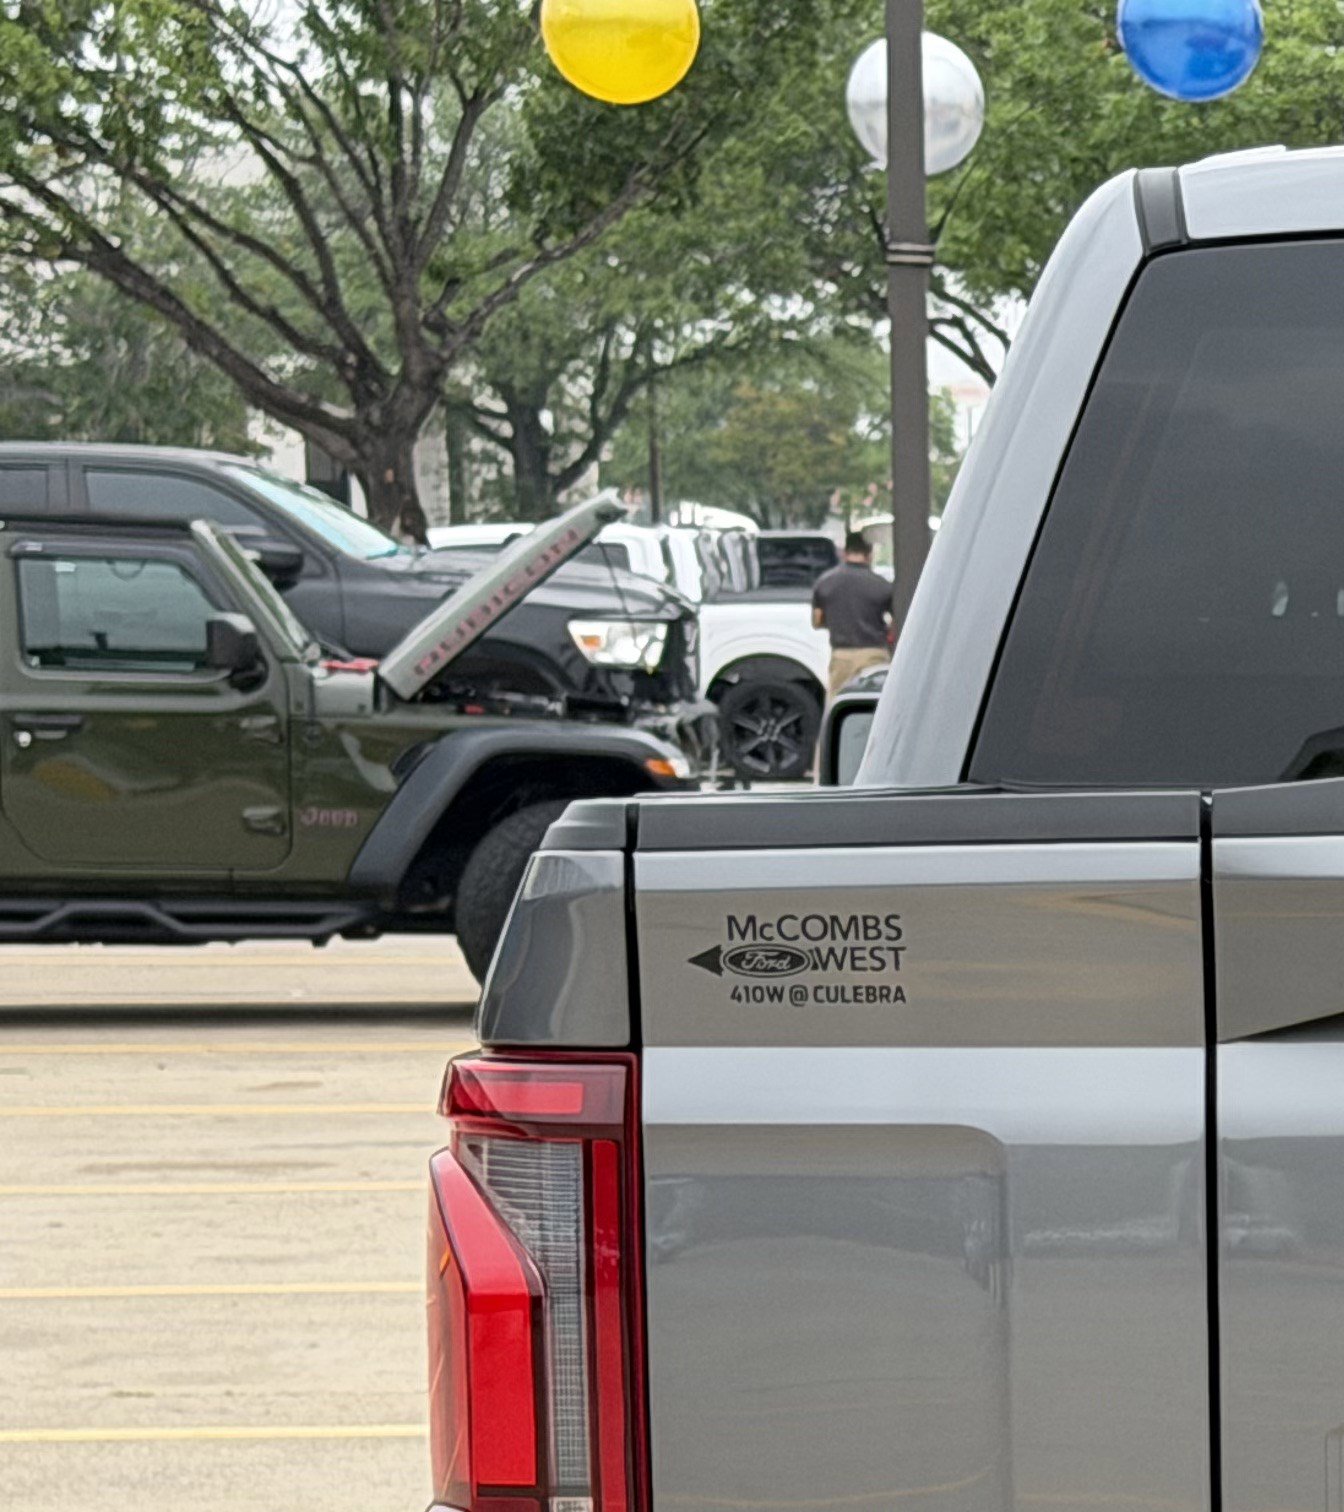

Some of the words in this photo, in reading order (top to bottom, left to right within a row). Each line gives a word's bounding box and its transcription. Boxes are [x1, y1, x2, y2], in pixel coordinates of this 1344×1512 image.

[727, 915, 902, 941] McCOMBS
[741, 951, 790, 970] Ford
[815, 946, 906, 971] WEST
[730, 985, 784, 1004] 410W
[789, 984, 808, 1008] @
[813, 984, 906, 1004] CULEBRA
